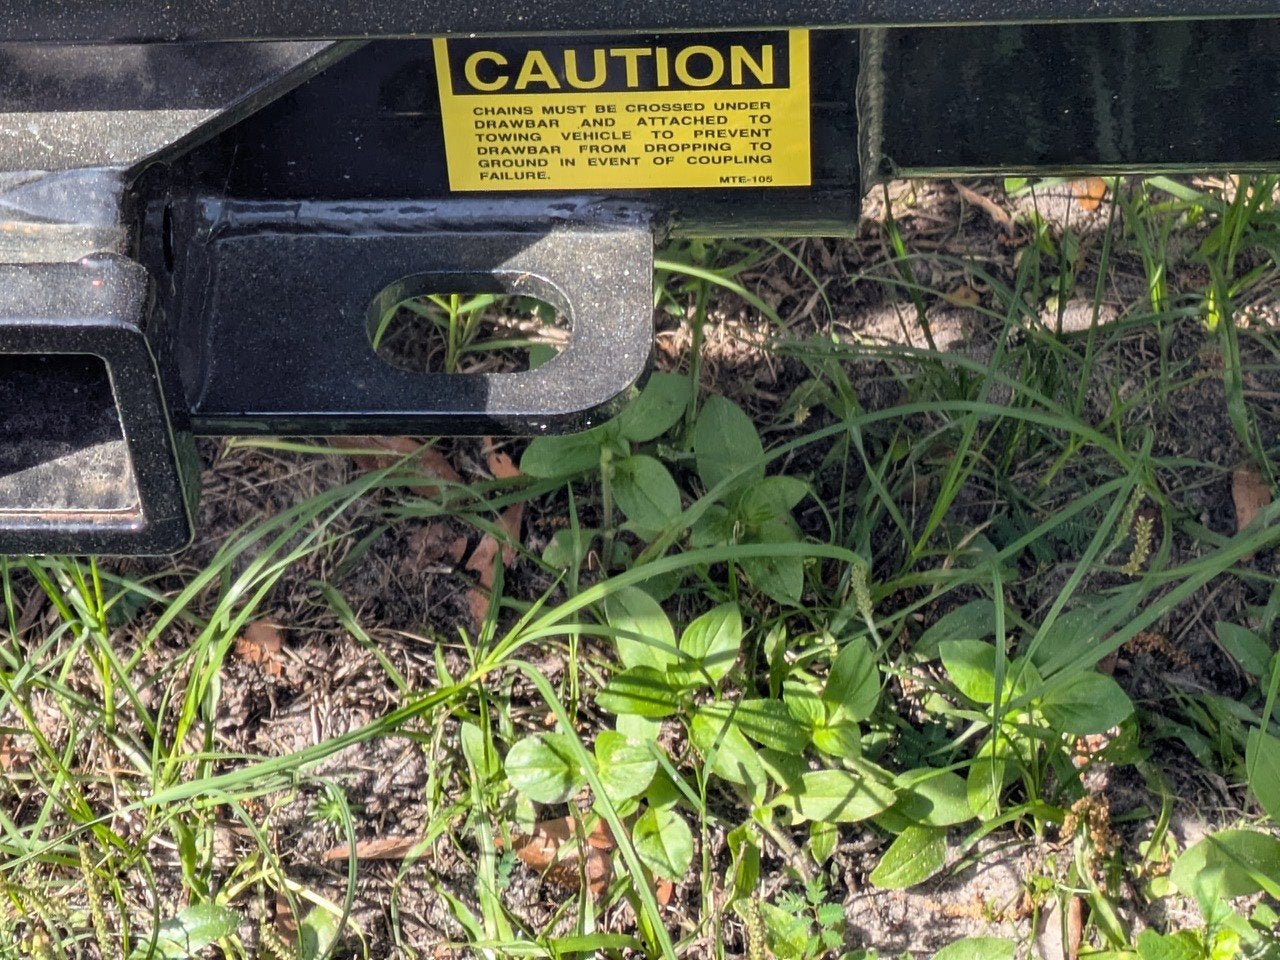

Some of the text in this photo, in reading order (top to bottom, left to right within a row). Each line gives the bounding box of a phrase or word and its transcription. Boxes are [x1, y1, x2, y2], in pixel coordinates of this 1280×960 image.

[464, 44, 774, 91] CAUTION
[473, 101, 771, 116] CHAINS MUST BE CROSSED UNDER
[474, 114, 771, 129] DRAWBAR AND ATTACHED TO
[476, 128, 772, 142] TOWING VEHICLE TO PREVENT
[477, 141, 772, 156] DRAWBAR FROM DROPPING TO
[478, 154, 772, 168] GROUND IN EVENT OF COUPLING
[480, 171, 551, 181] FAILURE.
